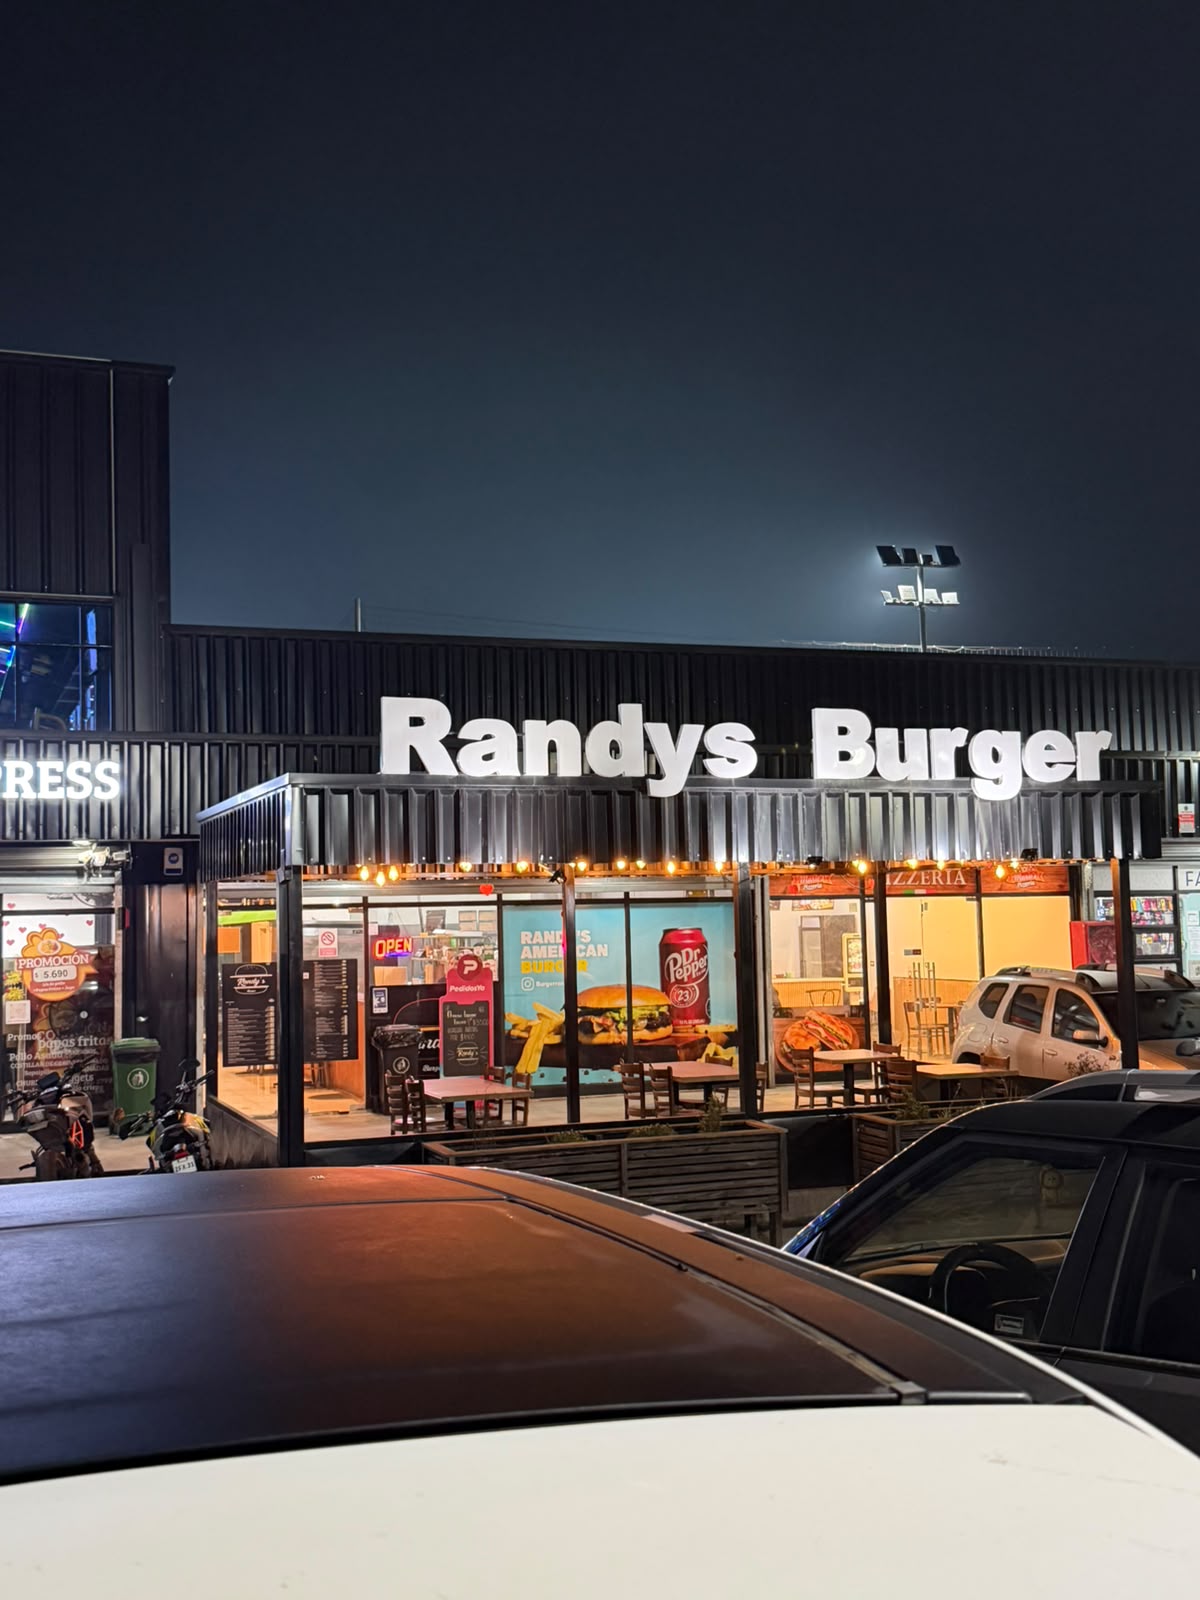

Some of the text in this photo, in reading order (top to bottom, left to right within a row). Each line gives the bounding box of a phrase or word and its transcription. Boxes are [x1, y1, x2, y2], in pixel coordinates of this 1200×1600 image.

[381, 696, 1113, 801] Randys Burger
[0, 760, 120, 800] RESS
[886, 869, 967, 886] IZZERIA
[520, 929, 592, 945] RAND'S
[375, 938, 412, 957] OPEN
[520, 944, 608, 959] AMECAN
[18, 952, 90, 969] PROMOCIÓN
[680, 947, 701, 966] Dr
[43, 969, 68, 979] 5.690
[521, 959, 588, 974] BURGR
[665, 953, 708, 983] Pepper
[449, 985, 486, 993] PedidosYa
[677, 989, 690, 1002] 23
